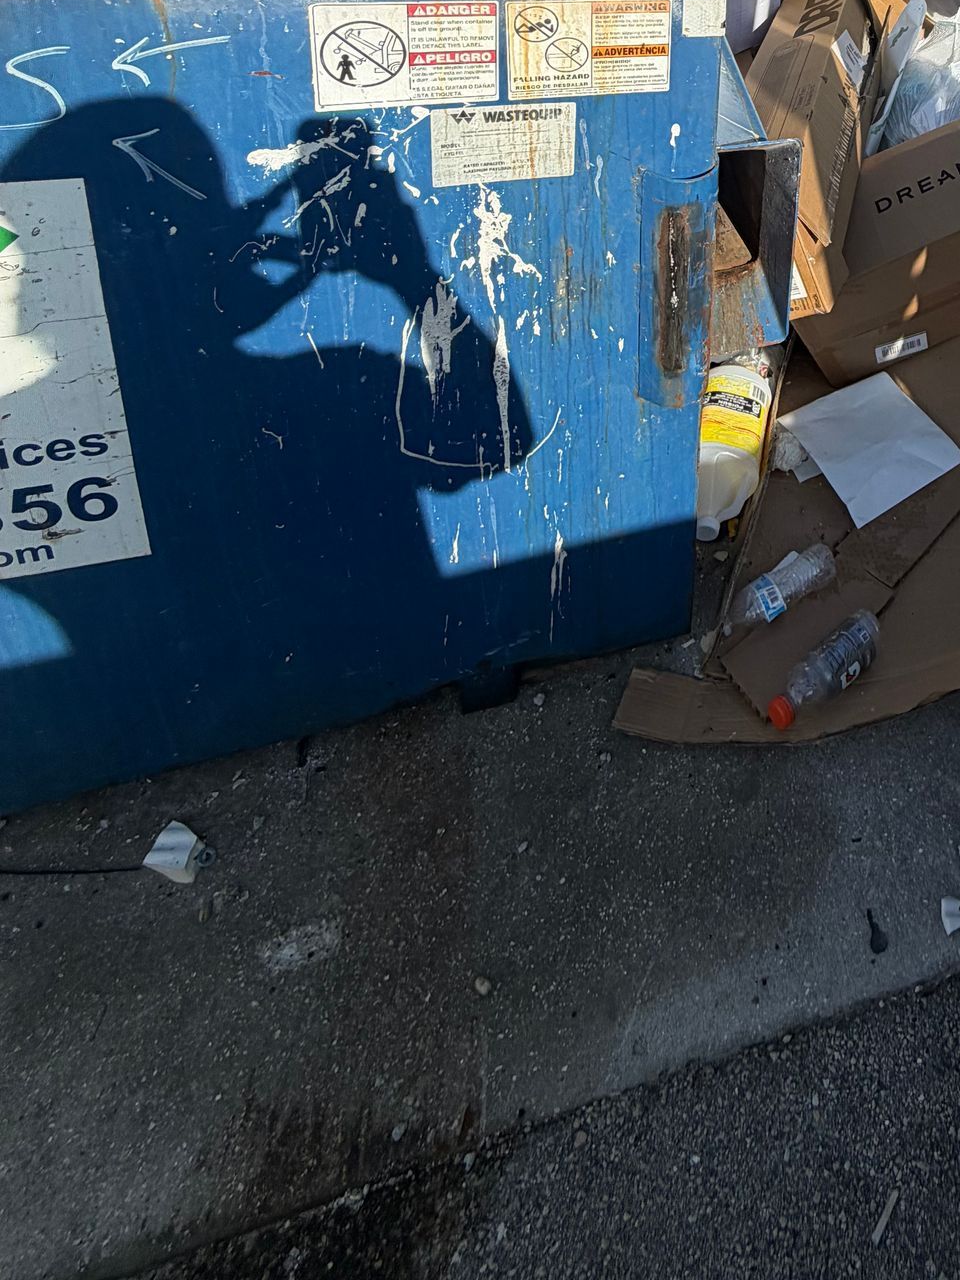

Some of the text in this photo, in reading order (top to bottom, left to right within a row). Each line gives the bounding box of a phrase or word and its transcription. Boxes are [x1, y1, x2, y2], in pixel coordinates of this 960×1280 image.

[425, 5, 491, 16] DANGER
[604, 2, 667, 12] WARNING
[425, 52, 492, 64] PELIGRO
[513, 75, 551, 83] FALLING
[553, 73, 590, 81] HAZARD
[482, 107, 563, 123] WASTEQUIP
[0, 476, 119, 531] 56
